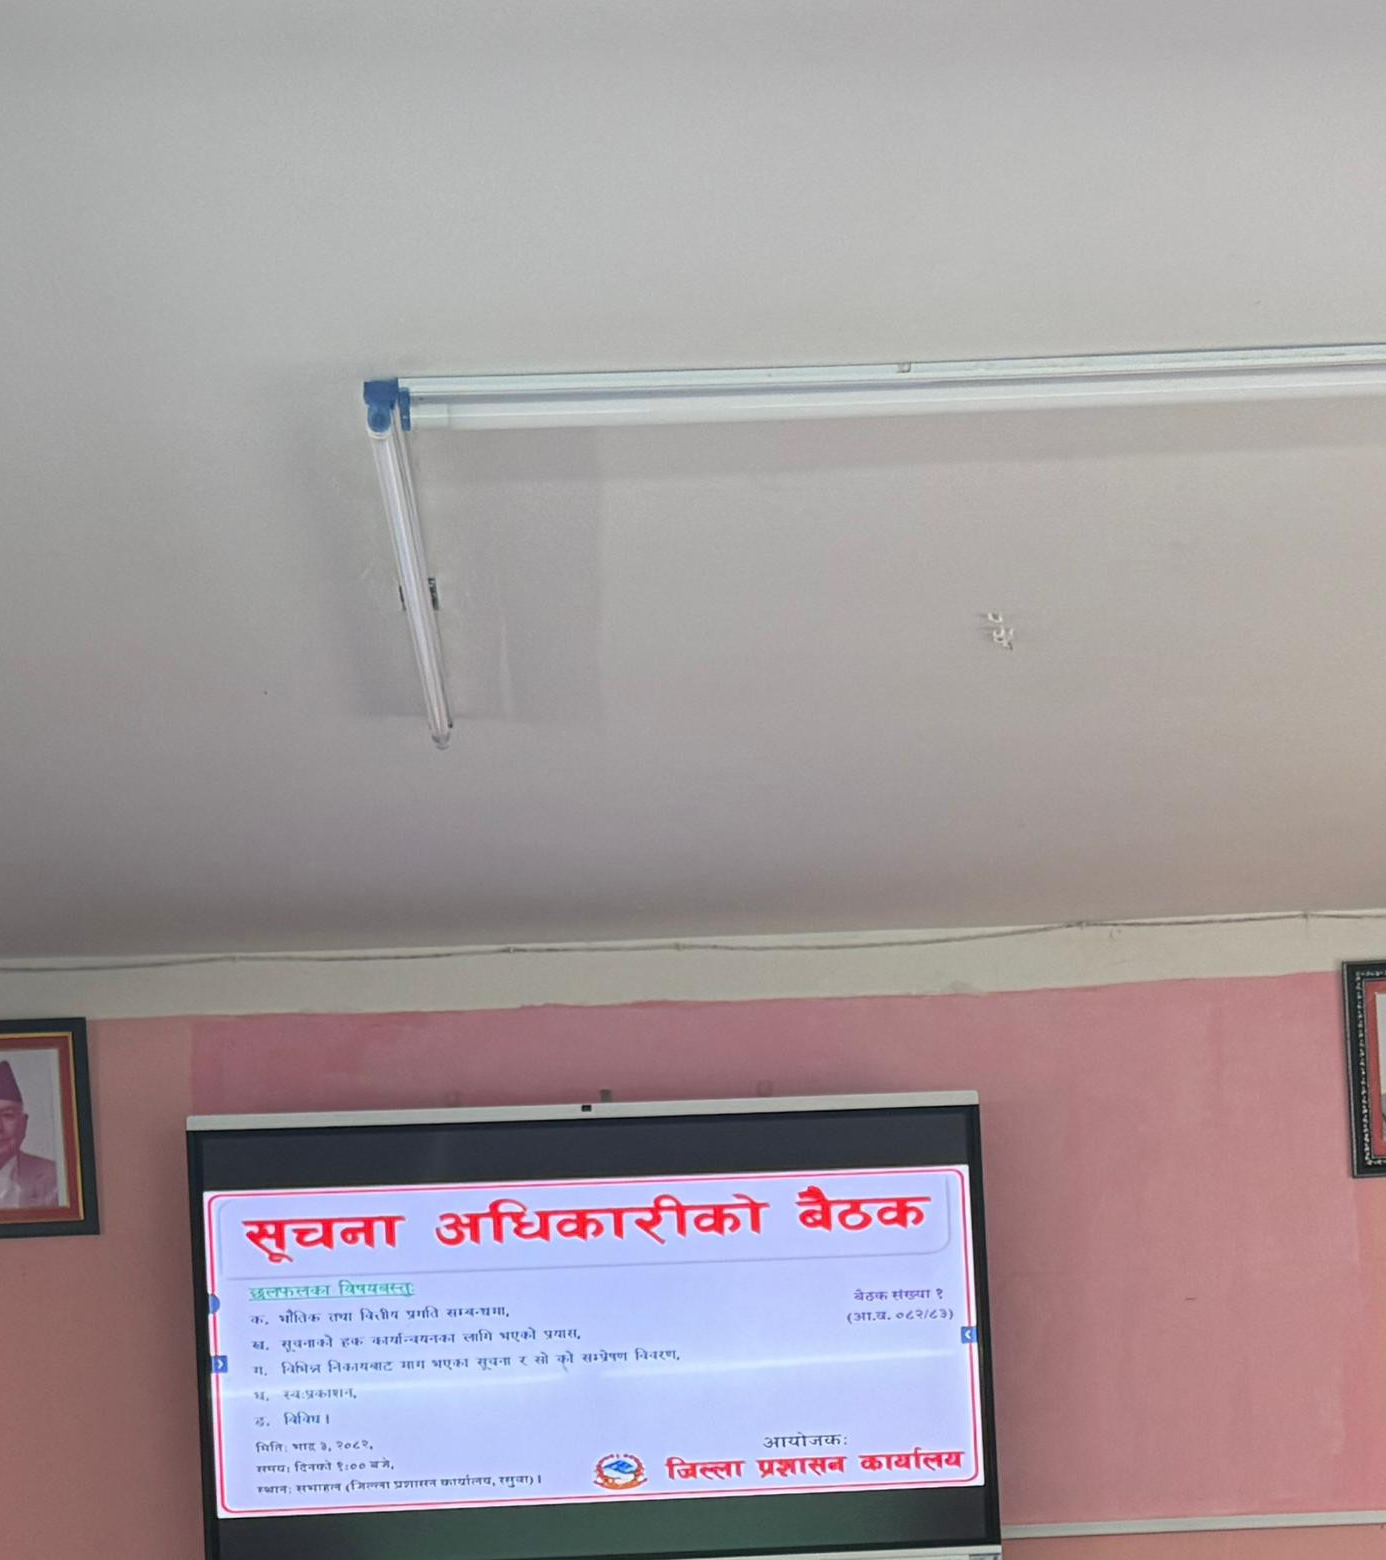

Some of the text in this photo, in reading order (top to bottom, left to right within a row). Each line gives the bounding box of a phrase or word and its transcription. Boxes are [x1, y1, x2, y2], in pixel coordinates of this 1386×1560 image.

[242, 1185, 932, 1263] सूचना अधिकारीको बैठक
[249, 1284, 331, 1301] छलफलका
[853, 1287, 945, 1301] बैठक संख्या १
[250, 1314, 269, 1327] क.
[278, 1308, 321, 1324] भौतिक
[328, 1311, 353, 1323] तथा
[360, 1307, 399, 1322] वित्तीय
[405, 1305, 440, 1320] प्रगति
[895, 1308, 955, 1321] ०८२/८३)
[281, 1334, 333, 1353] सूचनाको
[341, 1336, 364, 1348] हक
[372, 1331, 455, 1347] कार्यान्वयनका
[463, 1328, 493, 1343] लागि
[499, 1326, 537, 1343] भएको
[543, 1328, 582, 1341] प्रयास,
[281, 1360, 321, 1376] विभिन्न
[328, 1359, 394, 1374] निकायबाट
[401, 1359, 426, 1371] माग
[431, 1357, 469, 1371] भएका
[477, 1356, 512, 1372] सूचना
[519, 1354, 528, 1367] र
[534, 1350, 550, 1366] सो
[557, 1349, 574, 1365] को
[582, 1348, 629, 1364] सम्प्रेषण
[635, 1347, 681, 1362] विवरण,
[284, 1410, 321, 1425] विविध
[336, 1438, 374, 1451] २०८२,
[294, 1458, 332, 1473] दिनको
[665, 1446, 966, 1481] जिल्ला प्रशासन कार्यालय
[394, 1477, 437, 1490] प्रशासन
[499, 1474, 534, 1489] रसुवा)
